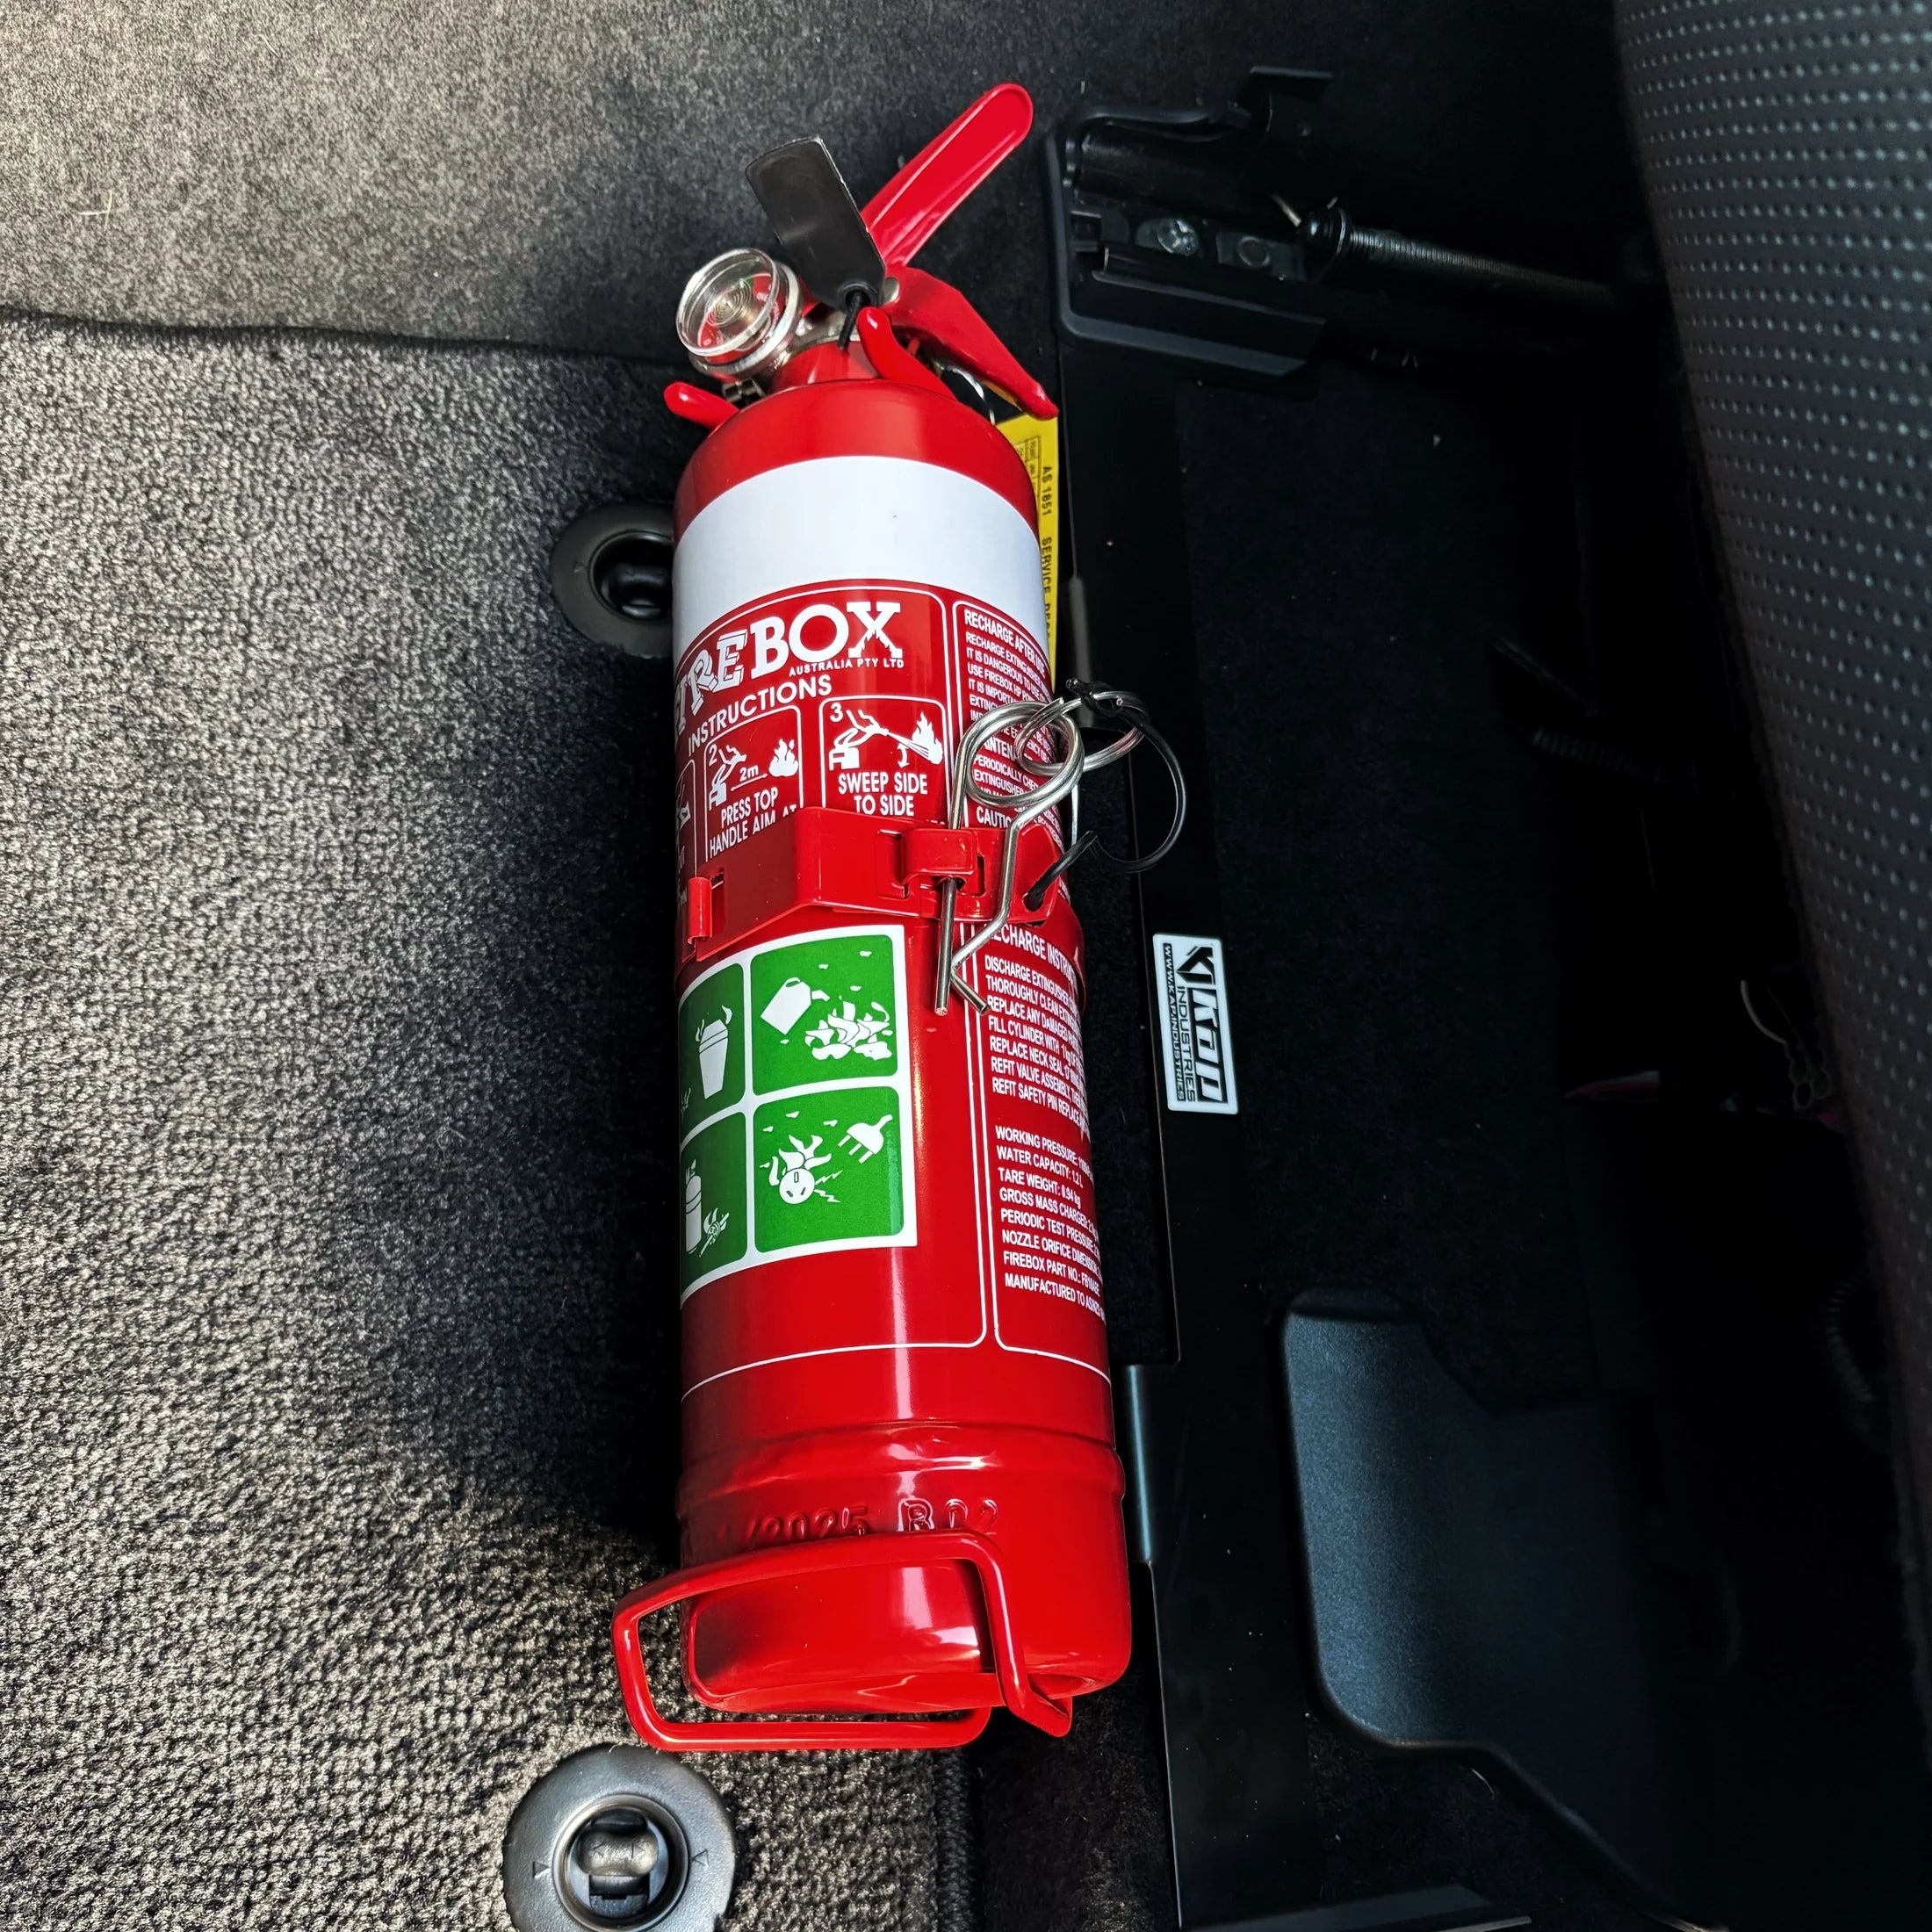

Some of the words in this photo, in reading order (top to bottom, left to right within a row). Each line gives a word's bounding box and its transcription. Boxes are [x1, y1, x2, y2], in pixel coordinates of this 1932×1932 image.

[1042, 466, 1052, 483] AS
[1042, 487, 1052, 515] 1851
[964, 609, 1014, 647] RECHARGE
[1015, 635, 1036, 666] AFTER
[966, 631, 1006, 659] RECHARGE
[789, 660, 853, 677] AUSTRALIA
[857, 659, 879, 668] PTY
[883, 659, 905, 668] LTD
[967, 647, 974, 660] IT
[975, 650, 983, 663] IS
[984, 653, 1024, 685] DANGEROUS
[1023, 676, 1031, 690] TO
[968, 662, 984, 679] USE
[984, 668, 1013, 692] FIREBOX
[969, 678, 976, 690] IT
[977, 681, 984, 694] IS
[688, 674, 833, 757] INSTRUCTIONS
[830, 703, 843, 722] 3
[709, 744, 717, 767] 2
[974, 754, 1023, 782] PERIODICALLY
[739, 765, 759, 782] 2m
[839, 772, 889, 794] SWEEP
[894, 773, 927, 795] SIDE
[721, 797, 751, 829] PRESS
[753, 787, 778, 812] TOP
[854, 795, 876, 815] TO
[880, 796, 914, 816] SIDE
[710, 820, 748, 858] HANDLE
[753, 811, 775, 834] AIM
[984, 955, 1031, 983] DISCHARGE
[985, 975, 1038, 1005] THOROUGHLY
[1040, 993, 1060, 1017] CLEAN
[987, 995, 1026, 1020] REPLACE
[1027, 1006, 1041, 1026] ANY
[989, 1015, 1005, 1034] FILL
[1008, 1020, 1044, 1047] CYLINDER
[1045, 1033, 1059, 1055] WITH
[1177, 985, 1196, 1103] INDUSTRIES
[990, 1036, 1028, 1060] REPLACE
[1029, 1047, 1049, 1068] NECK
[991, 1056, 1014, 1073] REFIT
[1016, 1063, 1041, 1084] VALVE
[992, 1077, 1016, 1096] REFIT
[1018, 1083, 1046, 1107] SAFETY
[995, 1125, 1041, 1149] WORKING
[997, 1145, 1031, 1166] WATER
[1033, 1153, 1071, 1180] CAPACITY:
[998, 1168, 1026, 1184] TARE
[1026, 1173, 1061, 1196] WEIGHT:
[999, 1187, 1034, 1208] GROSS
[1035, 1196, 1058, 1215] MASS
[1000, 1208, 1045, 1229] PERIODIC
[1046, 1217, 1065, 1236] TEST
[1002, 1229, 1040, 1250] NOZZLE
[1042, 1237, 1072, 1259] ORIFICE
[1004, 1251, 1045, 1272] FIREBOX
[1047, 1258, 1066, 1278] PART
[1005, 1272, 1076, 1302] MANUFACTURED
[1076, 1290, 1085, 1307] TO
